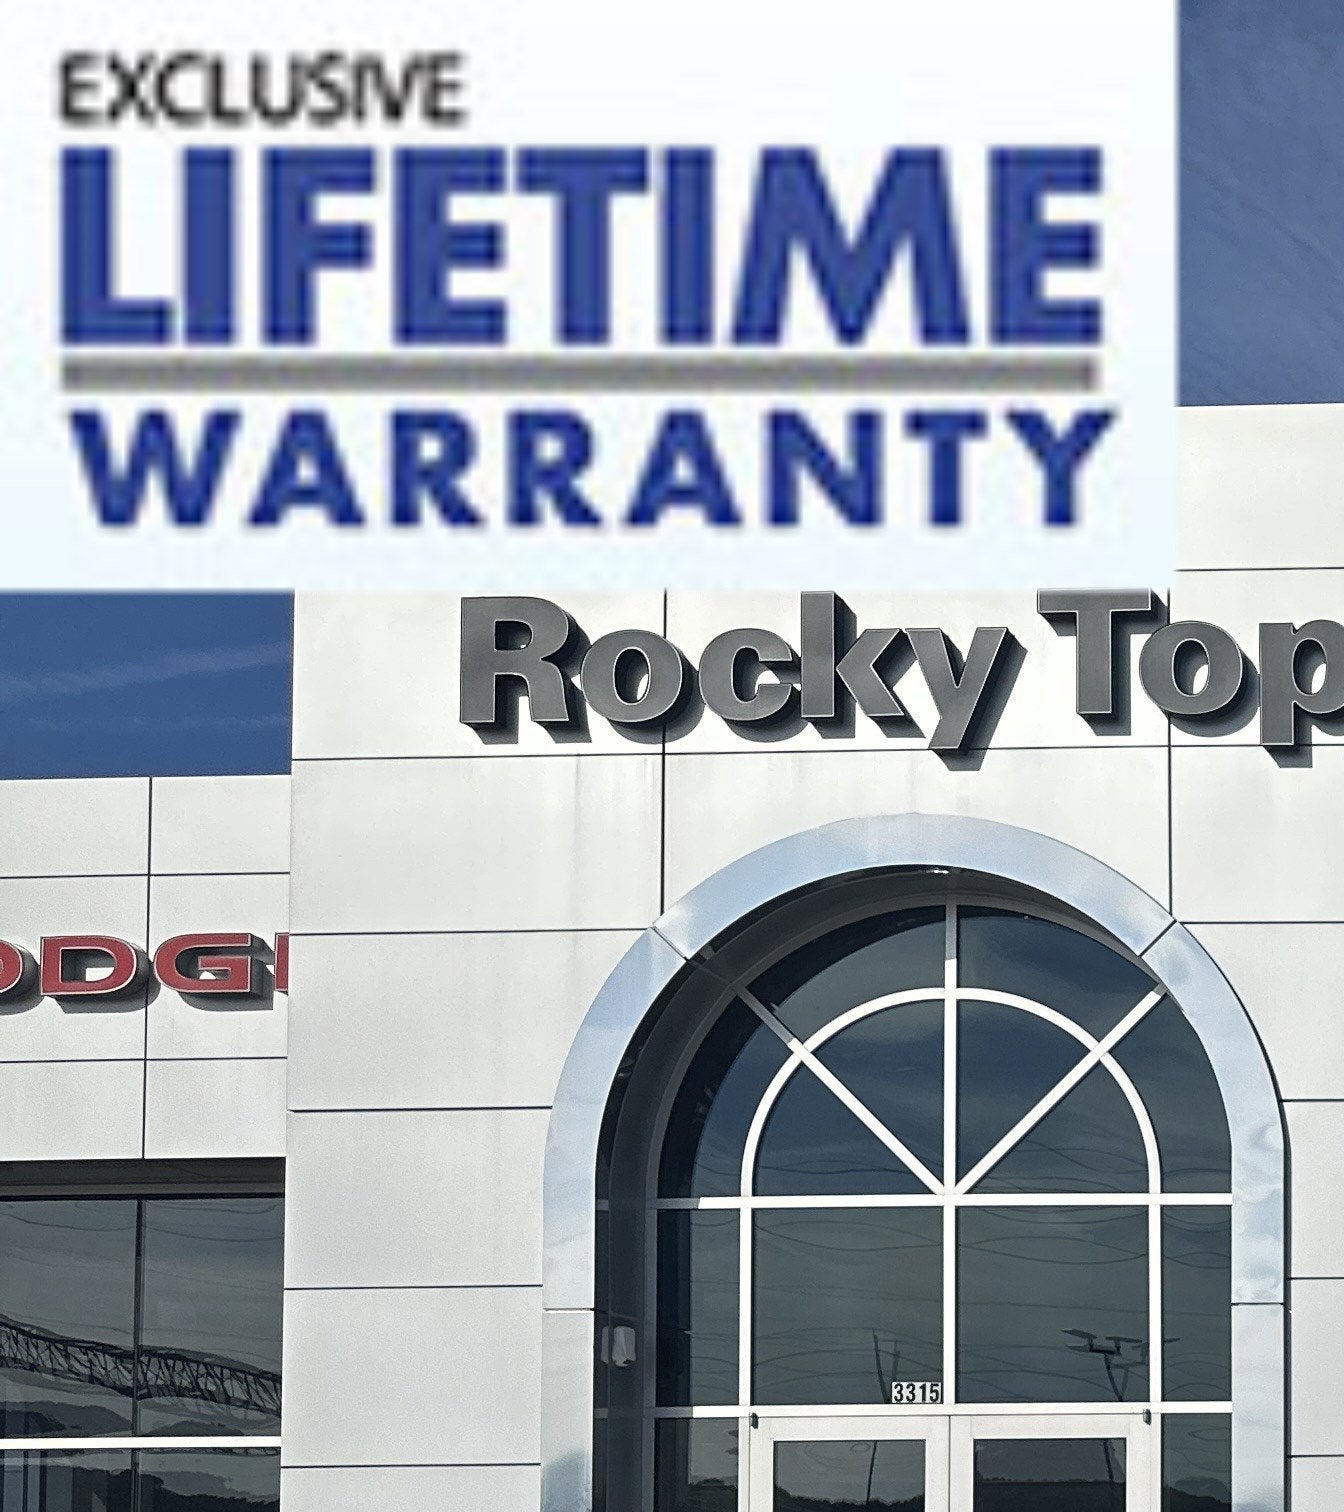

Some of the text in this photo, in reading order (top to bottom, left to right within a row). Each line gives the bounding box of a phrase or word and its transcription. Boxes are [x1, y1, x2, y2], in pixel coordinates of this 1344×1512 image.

[459, 590, 1020, 760] Rocky
[0, 931, 289, 997] DG
[893, 1382, 941, 1403] 3315
